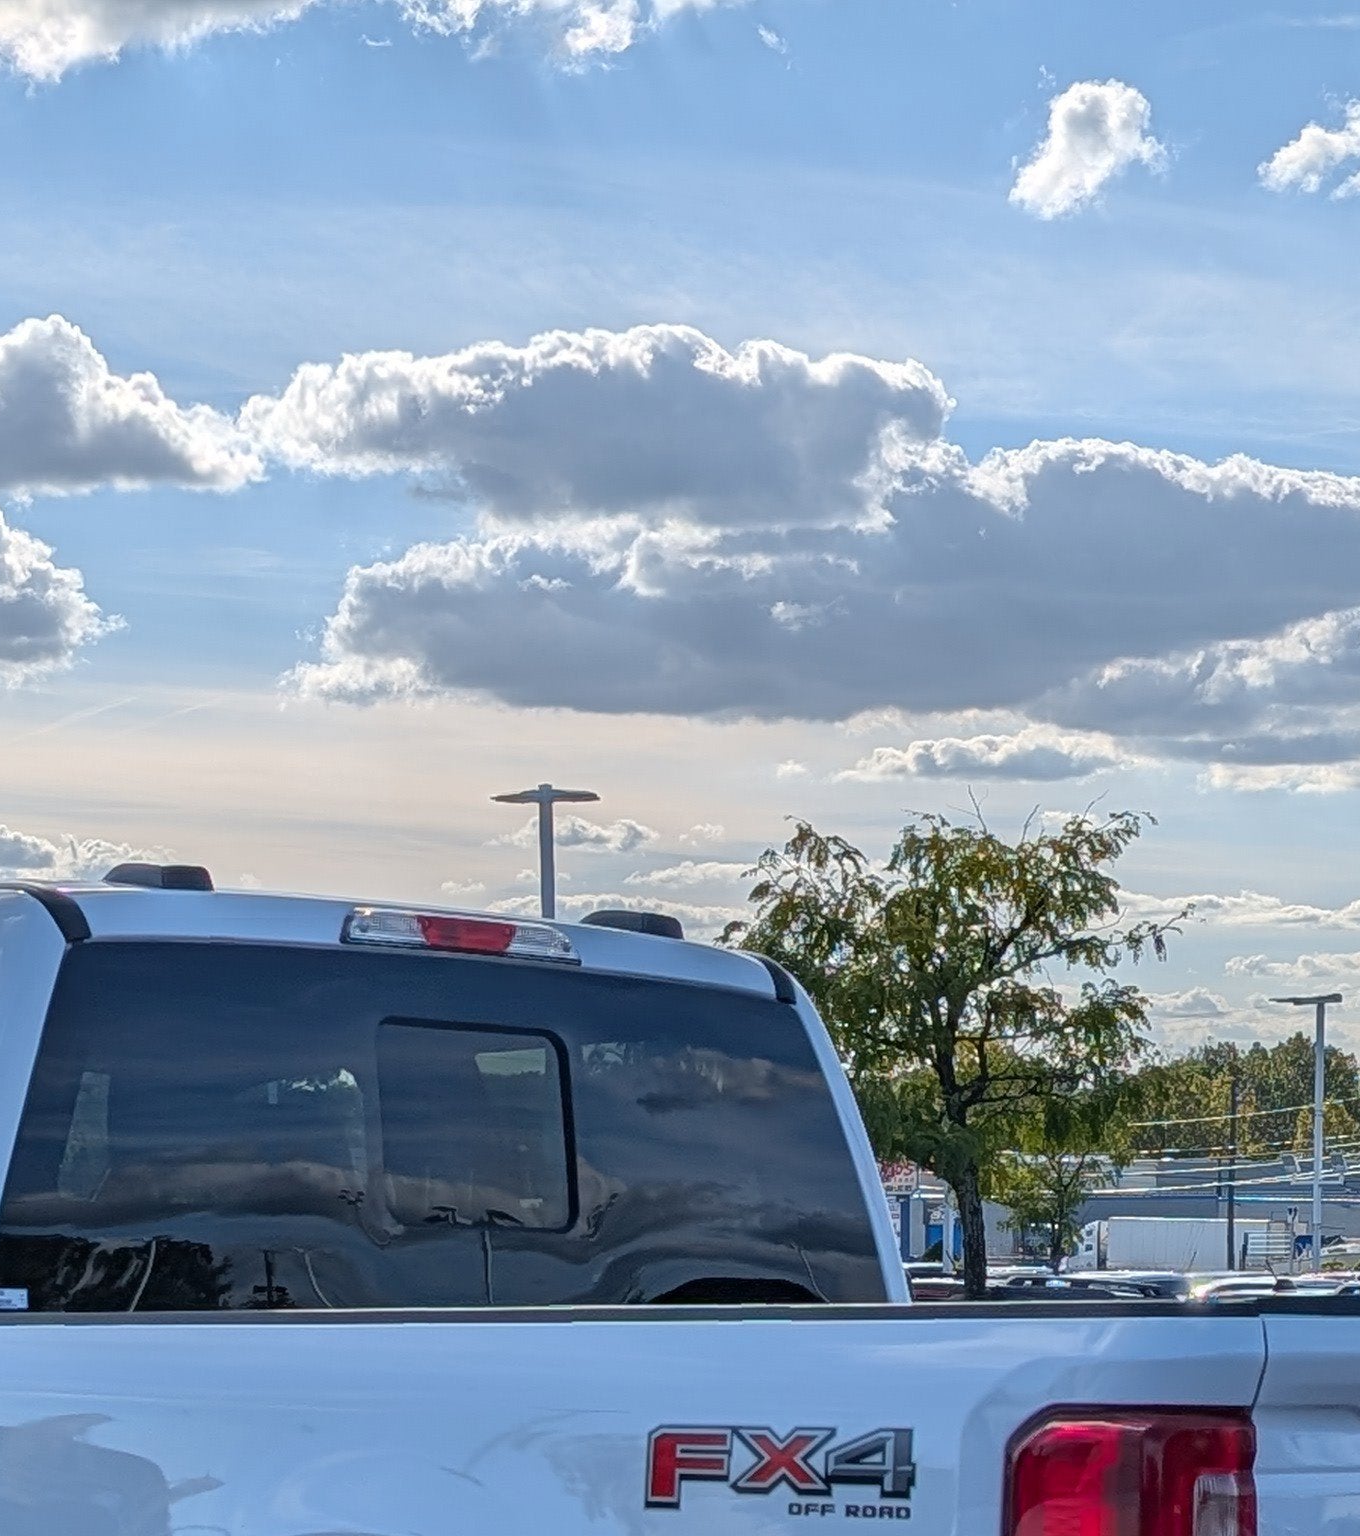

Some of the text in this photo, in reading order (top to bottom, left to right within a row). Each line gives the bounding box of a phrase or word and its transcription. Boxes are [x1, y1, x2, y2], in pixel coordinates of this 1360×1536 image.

[644, 1425, 916, 1509] FX4
[788, 1503, 911, 1520] OFF ROAD
